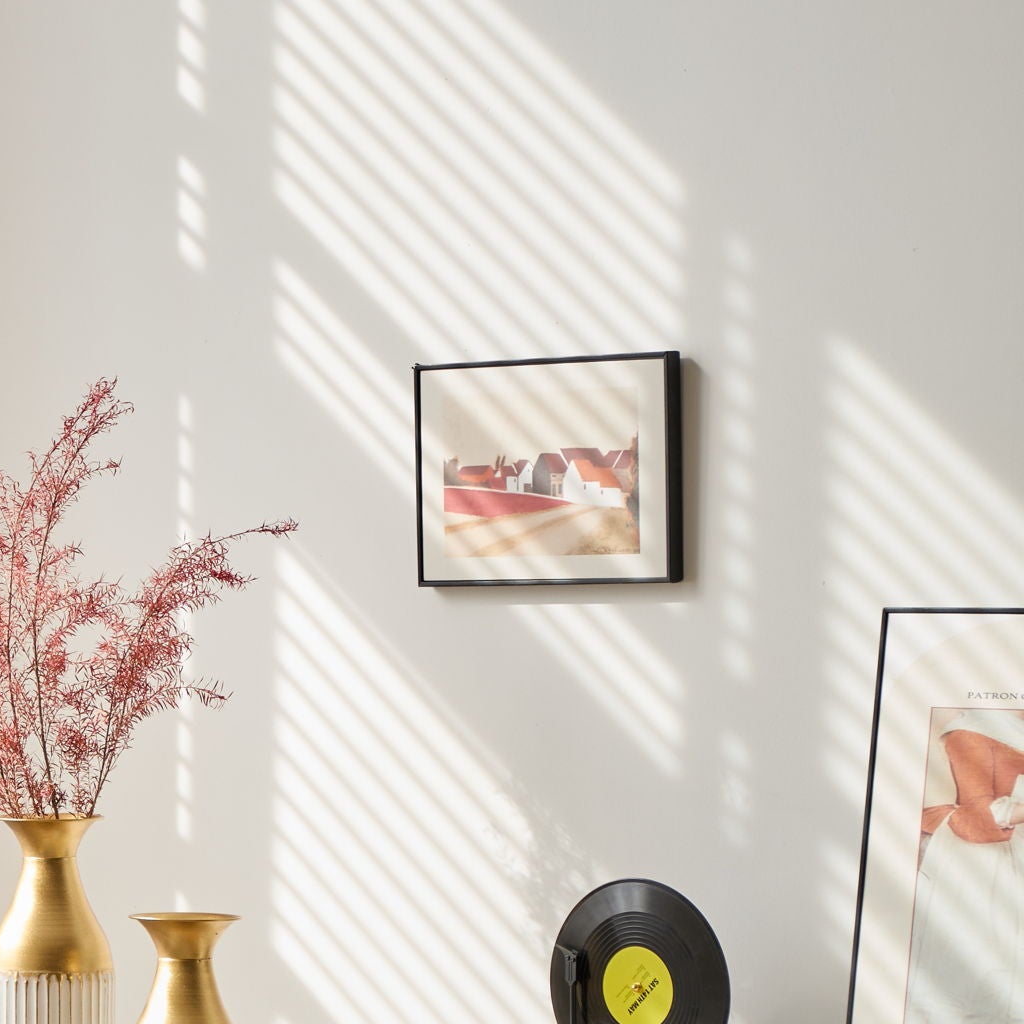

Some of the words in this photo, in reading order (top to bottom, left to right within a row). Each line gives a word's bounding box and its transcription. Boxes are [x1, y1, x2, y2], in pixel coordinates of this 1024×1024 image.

[967, 691, 1018, 700] PATRON
[649, 978, 659, 991] SAT
[627, 1000, 639, 1015] MAY
